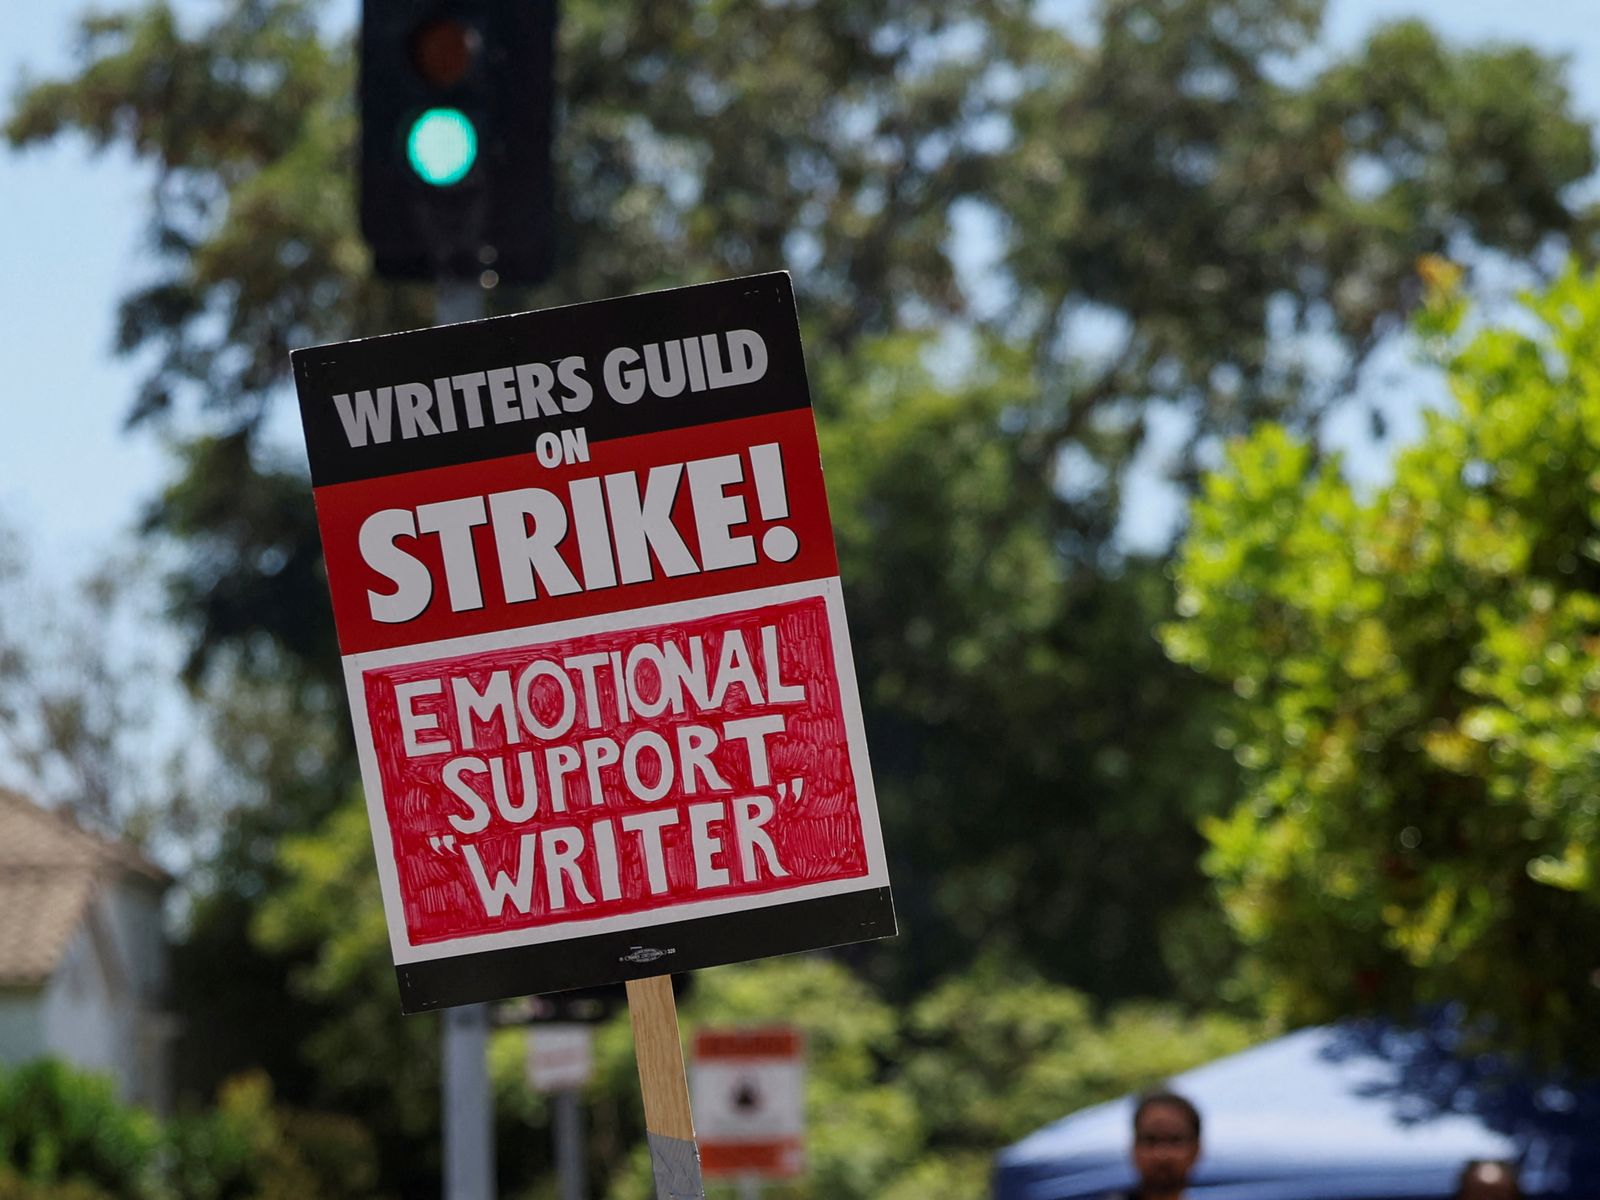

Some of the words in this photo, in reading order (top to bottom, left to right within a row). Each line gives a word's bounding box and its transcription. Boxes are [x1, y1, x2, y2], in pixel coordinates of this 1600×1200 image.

[332, 356, 594, 448] WRITERS
[603, 328, 769, 405] GUILD
[535, 427, 591, 469] ON
[358, 442, 800, 624] STRIKE!
[394, 625, 806, 757] EMOTIONAL
[442, 714, 787, 835] SUPPORT
